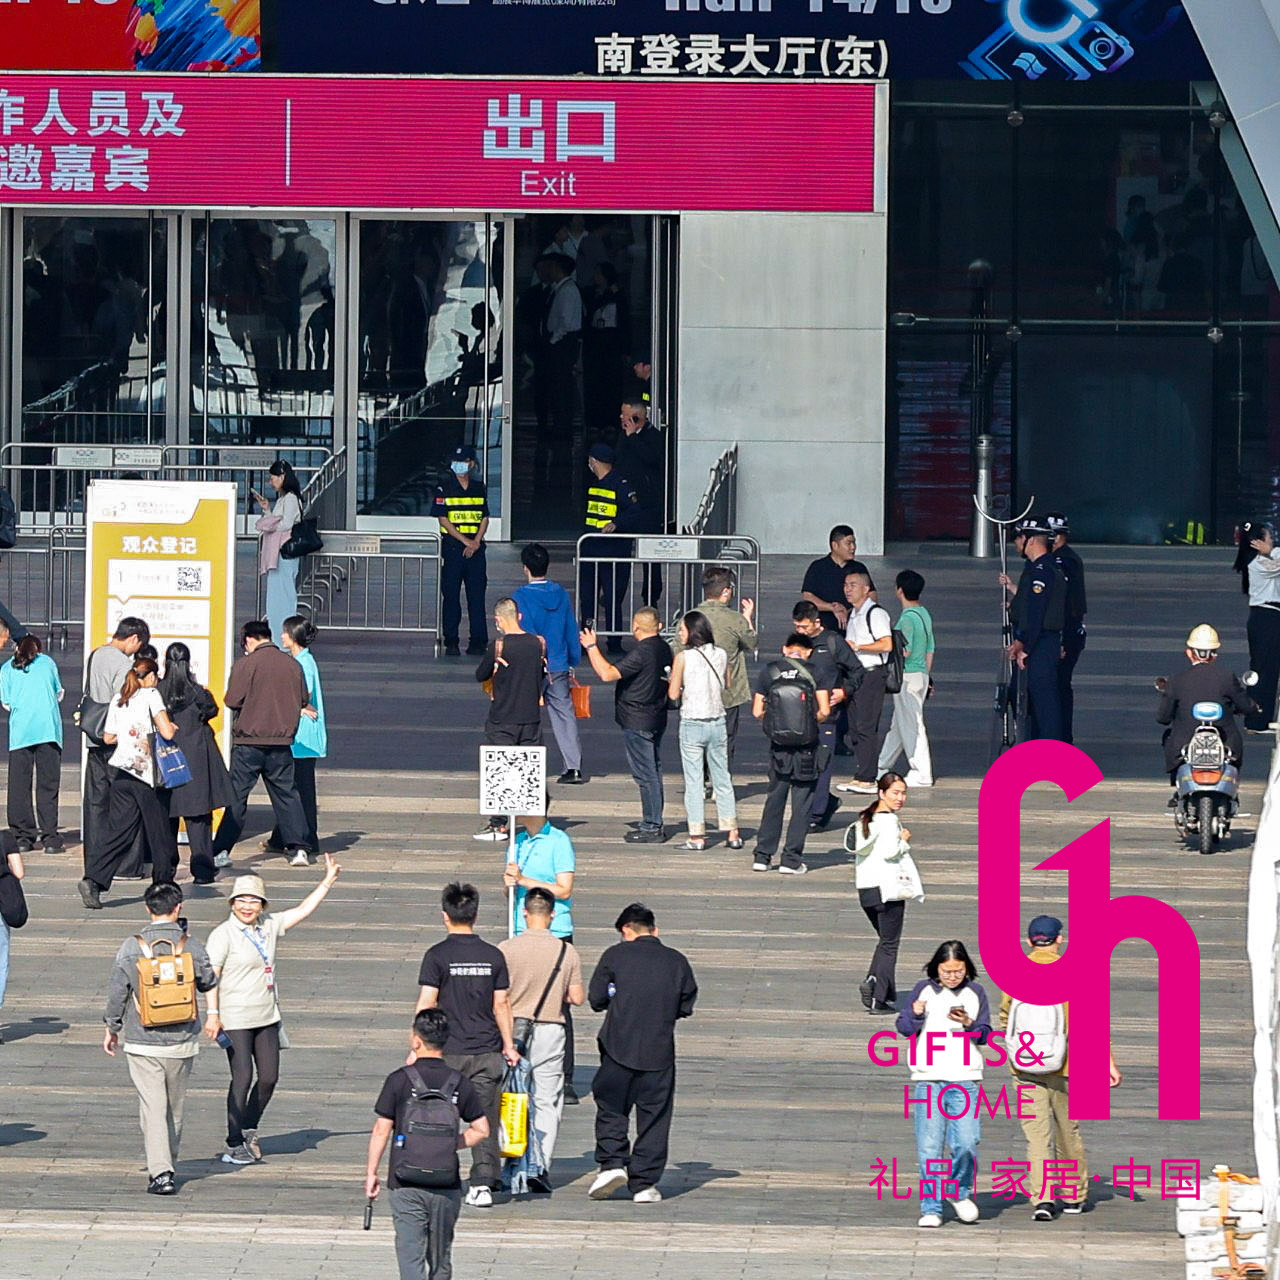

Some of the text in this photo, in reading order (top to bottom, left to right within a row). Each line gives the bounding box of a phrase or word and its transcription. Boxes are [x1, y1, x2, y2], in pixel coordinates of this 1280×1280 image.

[594, 32, 889, 78] 南登录大厅(东)
[482, 93, 618, 164] 出口
[521, 169, 576, 198] Exit
[121, 535, 198, 555] 观众登记
